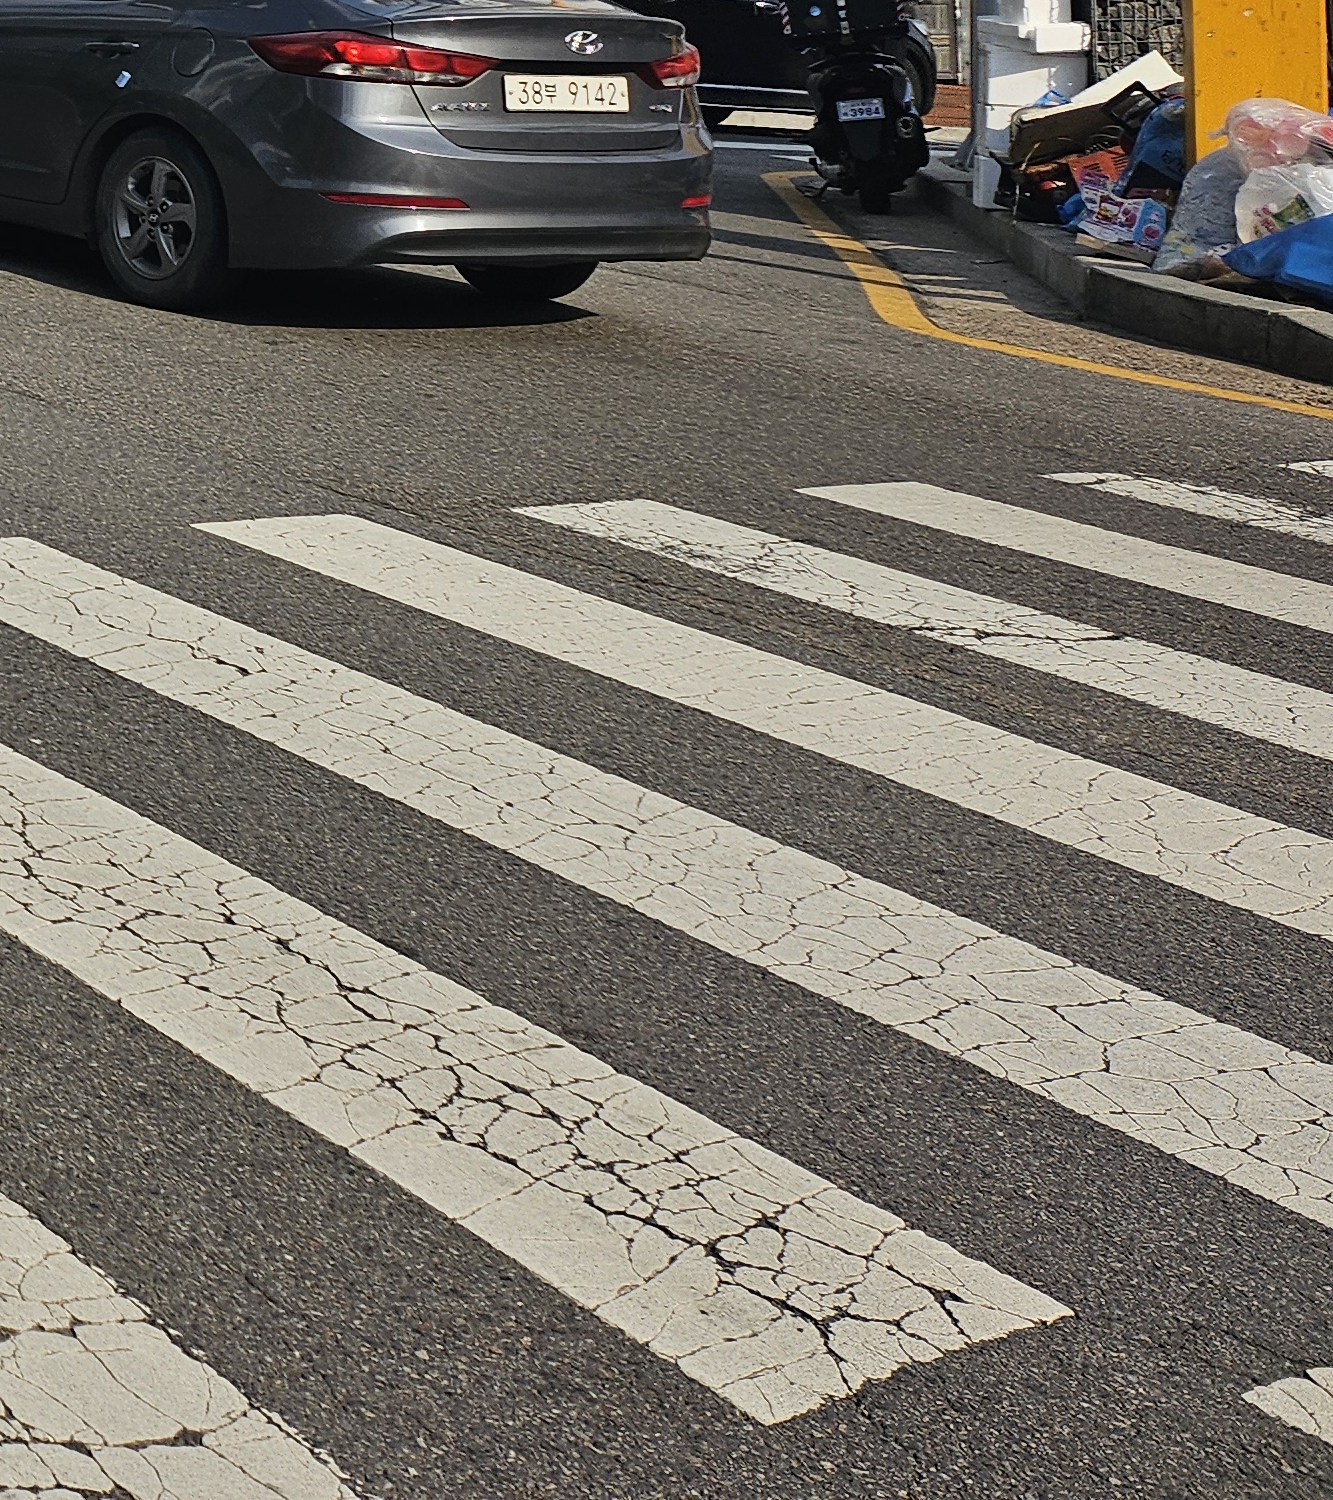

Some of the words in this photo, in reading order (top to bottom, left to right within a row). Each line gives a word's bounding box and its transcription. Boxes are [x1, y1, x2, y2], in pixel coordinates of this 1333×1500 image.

[517, 80, 558, 106] 38부
[567, 80, 618, 107] 9142
[850, 106, 881, 119] 3984
